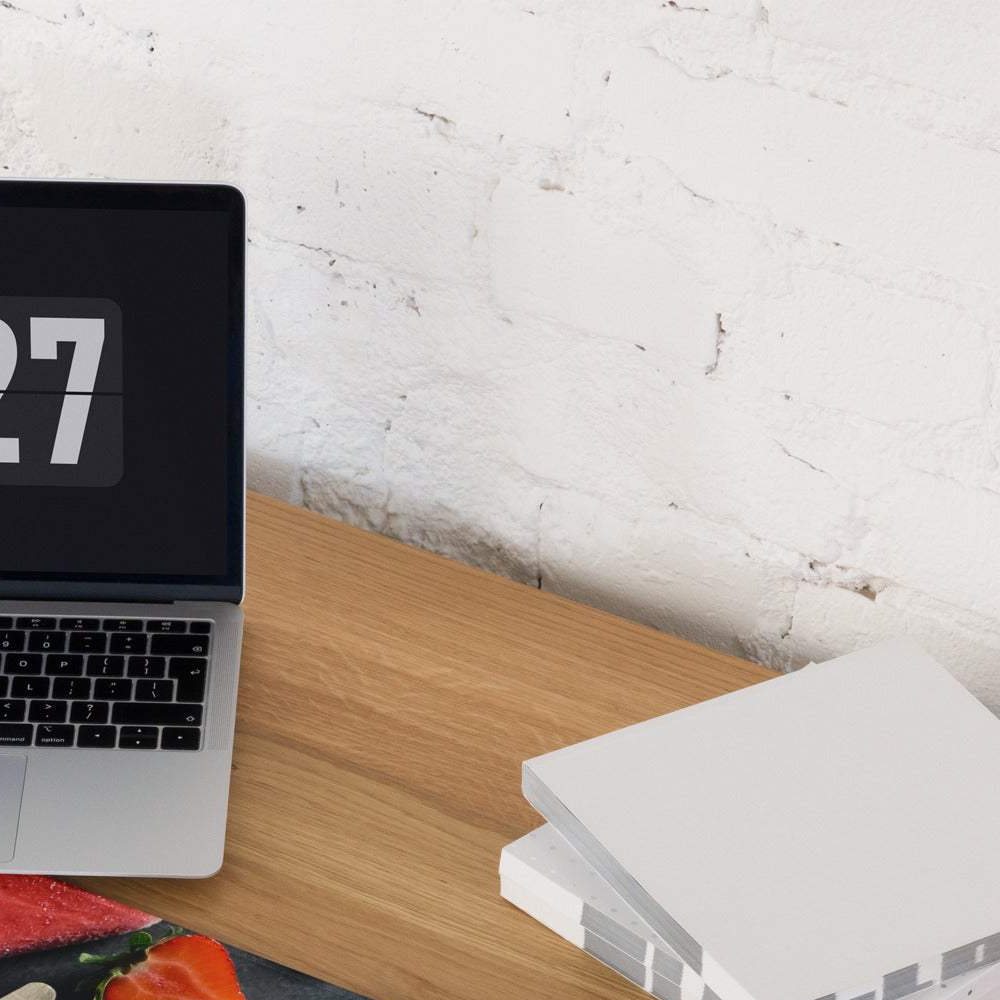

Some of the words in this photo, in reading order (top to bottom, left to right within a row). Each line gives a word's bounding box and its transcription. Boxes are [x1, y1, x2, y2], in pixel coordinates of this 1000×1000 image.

[1, 640, 10, 648] 9
[42, 641, 51, 649] 0
[18, 660, 28, 668] O
[26, 683, 34, 691] L
